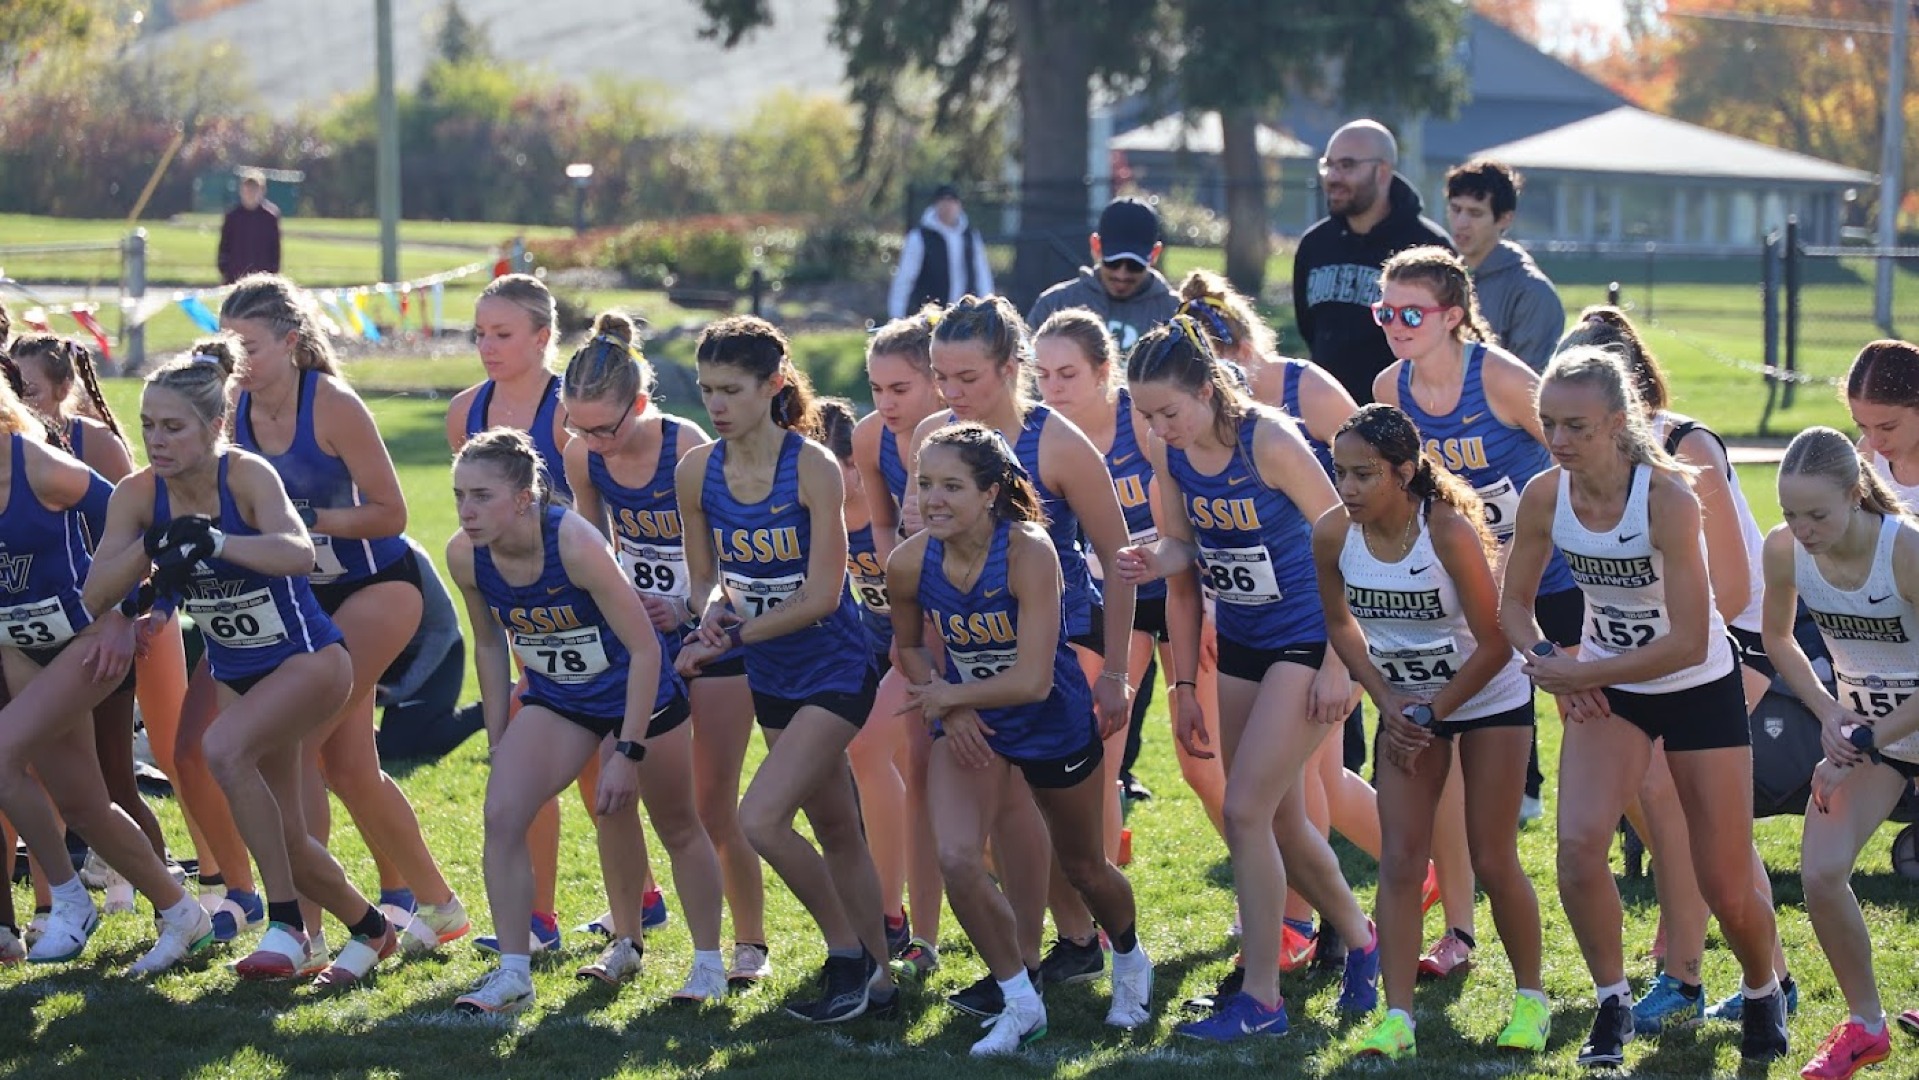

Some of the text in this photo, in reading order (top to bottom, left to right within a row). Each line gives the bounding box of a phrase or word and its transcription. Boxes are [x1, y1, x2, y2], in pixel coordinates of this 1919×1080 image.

[1425, 436, 1489, 470] SSU
[713, 526, 802, 563] LSSU
[634, 562, 675, 592] 89
[1210, 565, 1255, 592] 86
[1346, 586, 1439, 610] PURDUE
[8, 622, 56, 645] 53
[211, 614, 260, 638] 60
[931, 609, 1017, 645] LSSU
[537, 650, 587, 673] 78
[1382, 659, 1457, 682] 154
